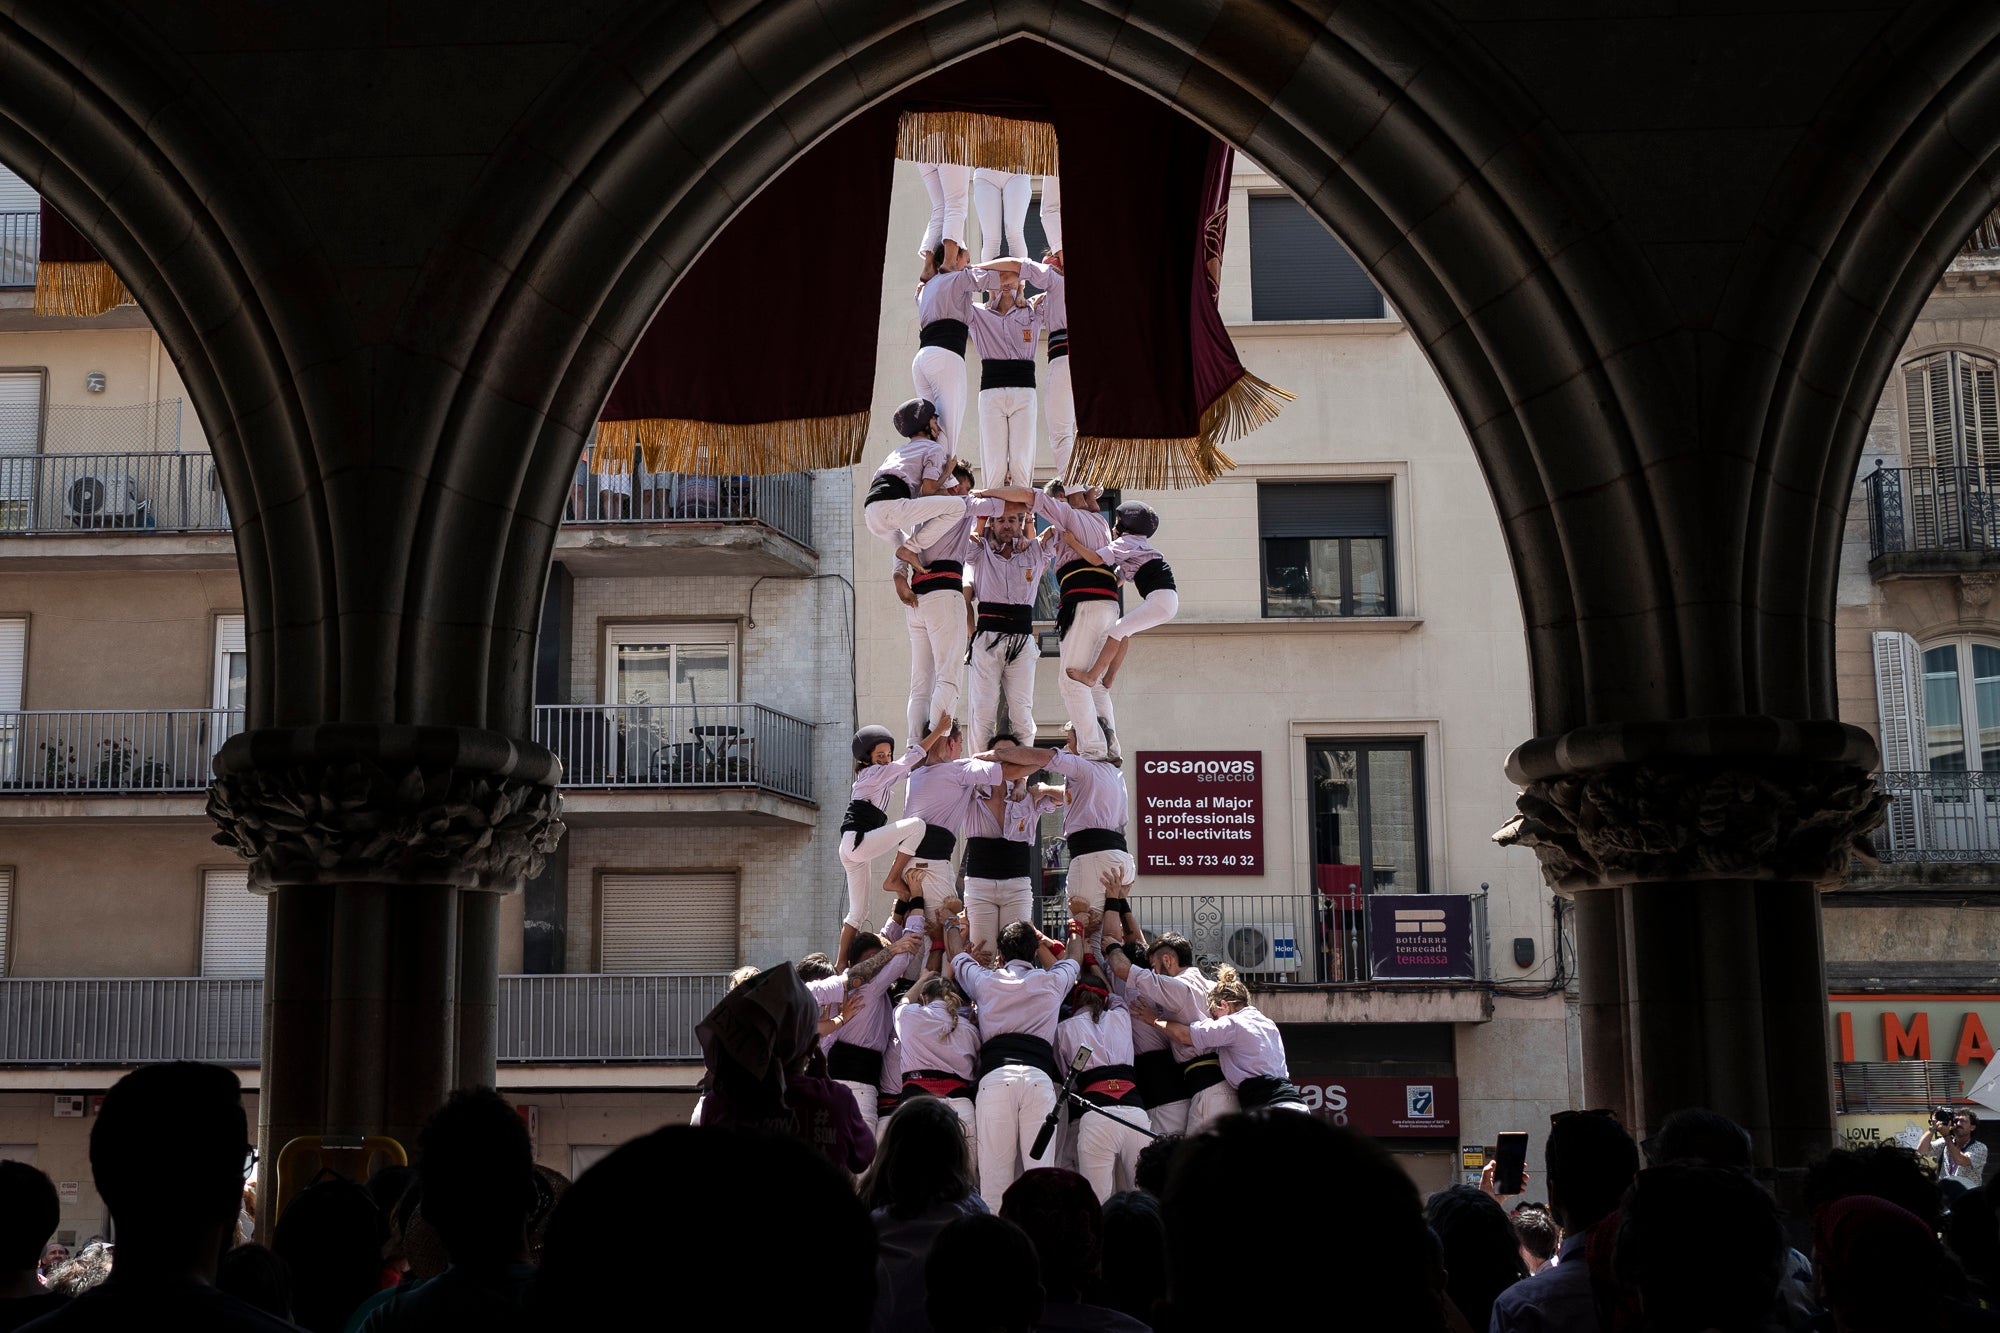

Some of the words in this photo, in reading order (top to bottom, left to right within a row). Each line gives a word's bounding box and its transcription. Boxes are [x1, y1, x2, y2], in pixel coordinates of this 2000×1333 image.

[1144, 760, 1255, 774] casanovas
[1146, 797, 1191, 808] Venda
[1195, 797, 1208, 808] al
[1212, 797, 1254, 811] Major
[1144, 815, 1153, 824] a
[1157, 812, 1255, 826] professionals
[1148, 828, 1153, 839] i
[1157, 828, 1252, 840] col·lectivitats
[1148, 855, 1176, 866] TEL.
[1179, 855, 1194, 866] 93
[1197, 855, 1219, 866] 733
[1222, 855, 1237, 866] 40
[1240, 855, 1255, 866] 32
[1846, 1127, 1881, 1140] LOVE
